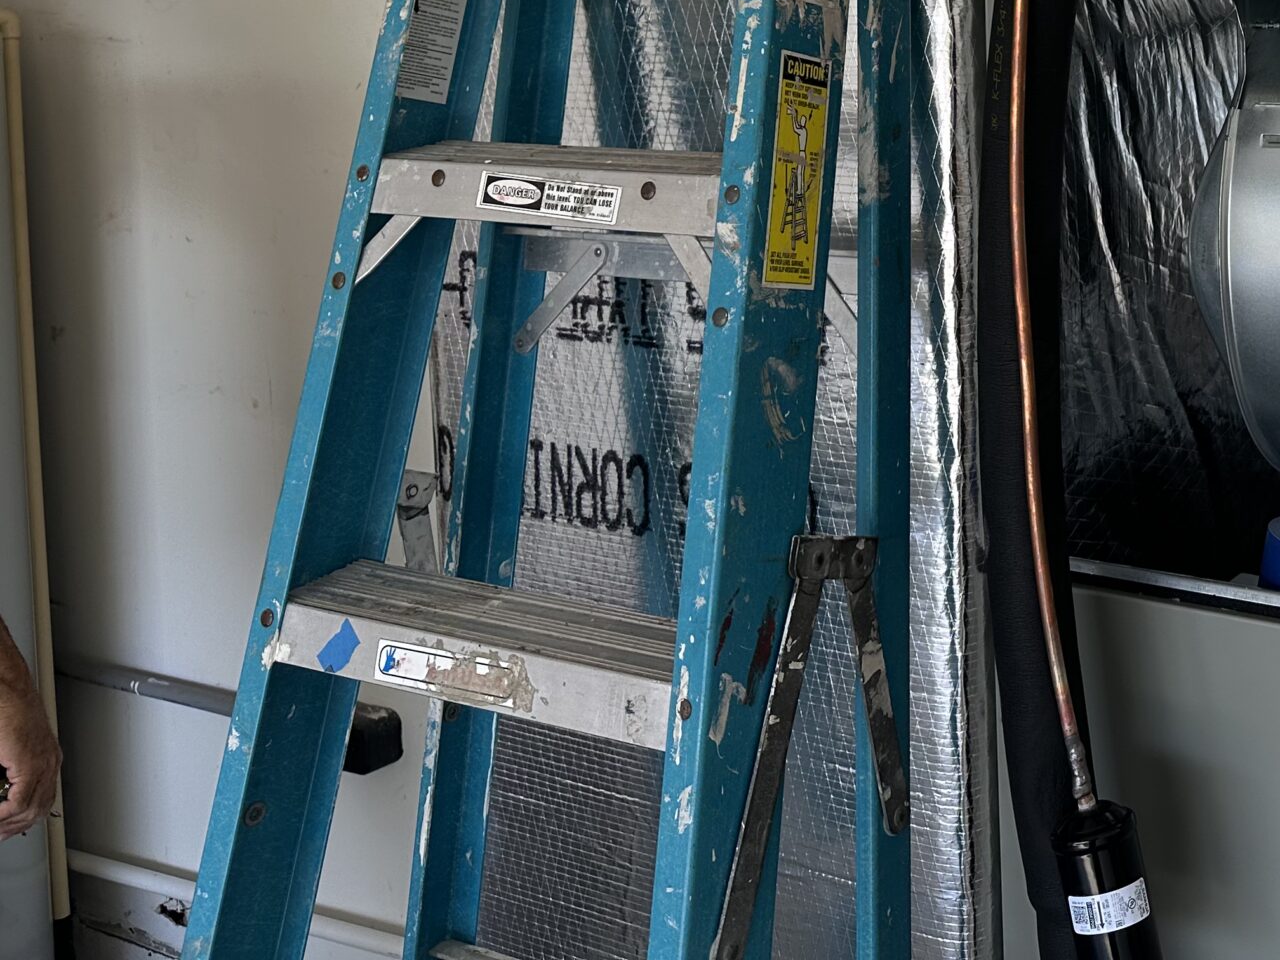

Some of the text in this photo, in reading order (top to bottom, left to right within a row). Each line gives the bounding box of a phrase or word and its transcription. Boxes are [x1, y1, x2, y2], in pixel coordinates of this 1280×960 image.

[786, 59, 826, 81] CAUTION
[492, 183, 536, 200] DANGER
[547, 183, 555, 191] Do
[556, 184, 565, 192] Not
[566, 186, 582, 194] Stand
[597, 190, 614, 198] above
[544, 202, 559, 211] YOUR
[572, 196, 584, 204] YOU
[585, 197, 597, 206] CAN
[598, 199, 612, 207] LOSE
